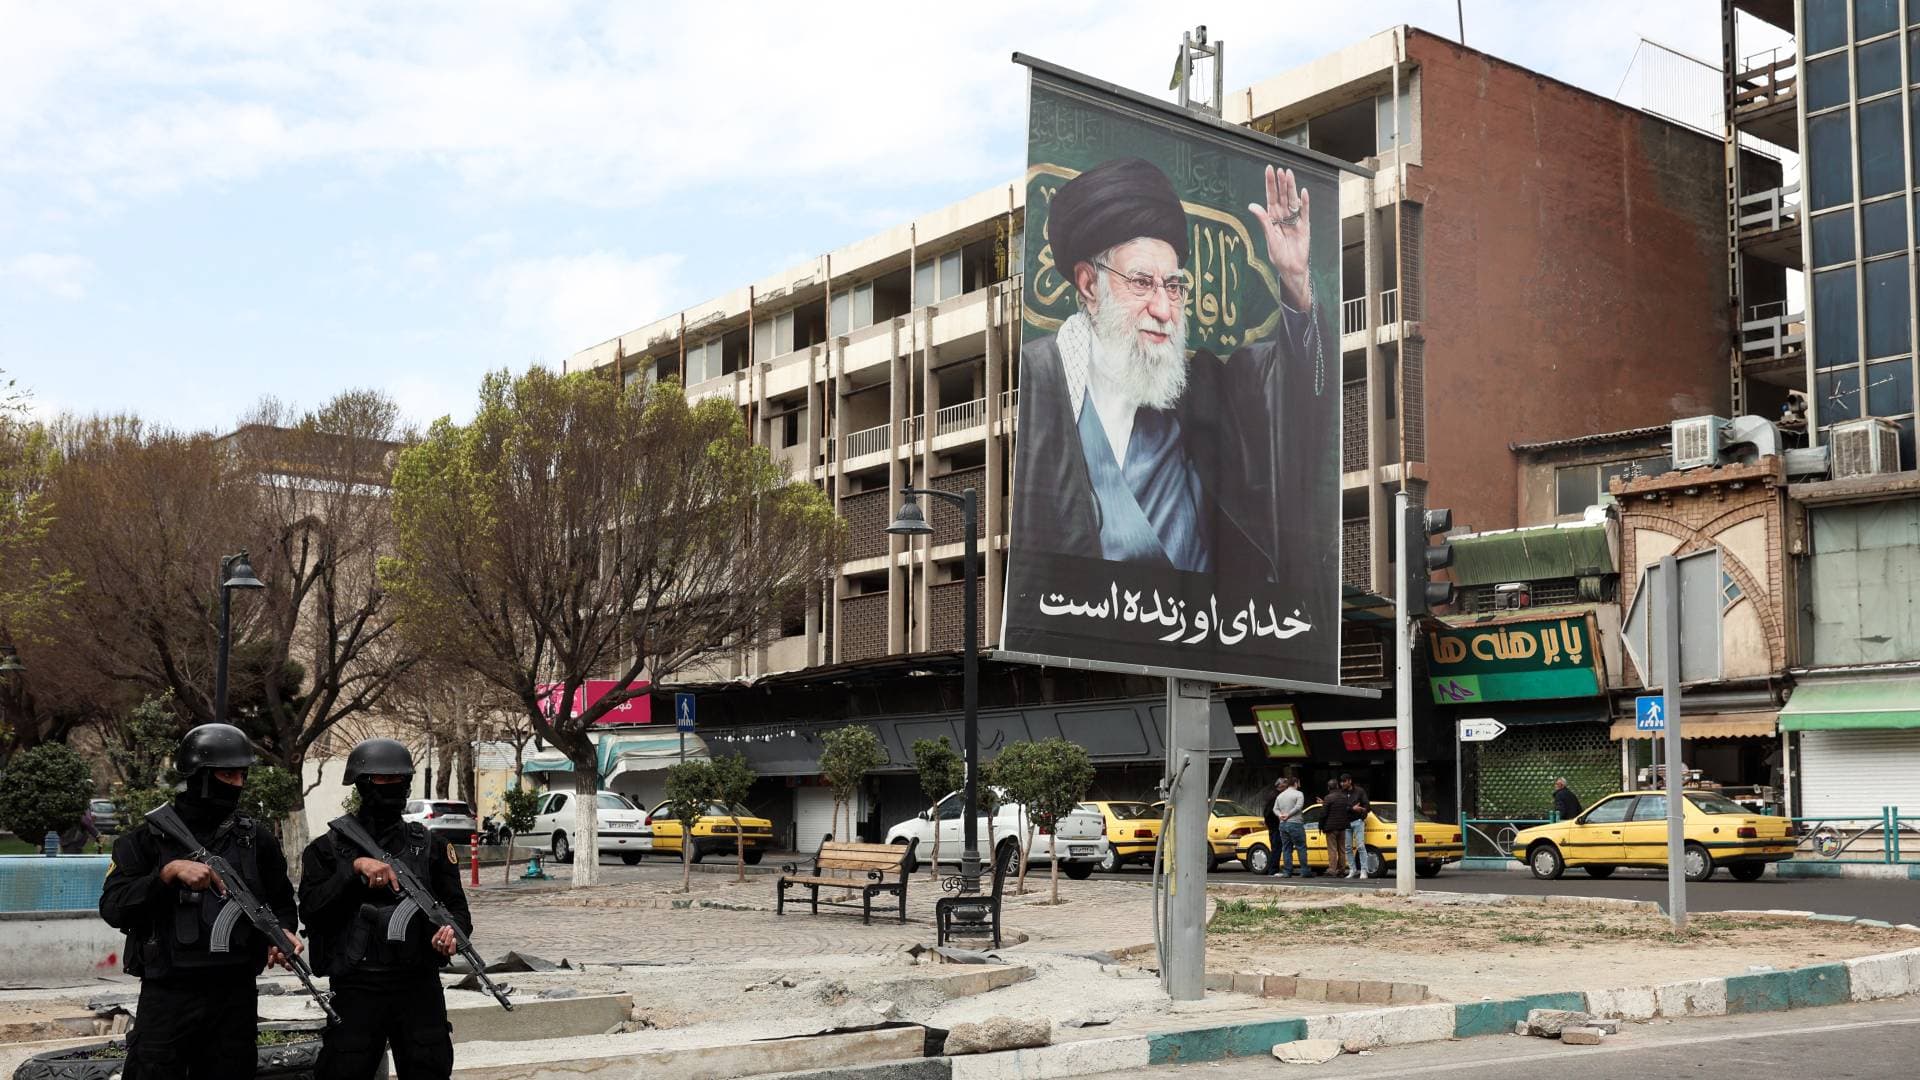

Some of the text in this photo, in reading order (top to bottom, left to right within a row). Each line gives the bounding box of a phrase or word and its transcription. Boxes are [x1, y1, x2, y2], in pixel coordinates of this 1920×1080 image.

[1039, 581, 1312, 645] خدای او زنده است
[1429, 631, 1467, 665] ها
